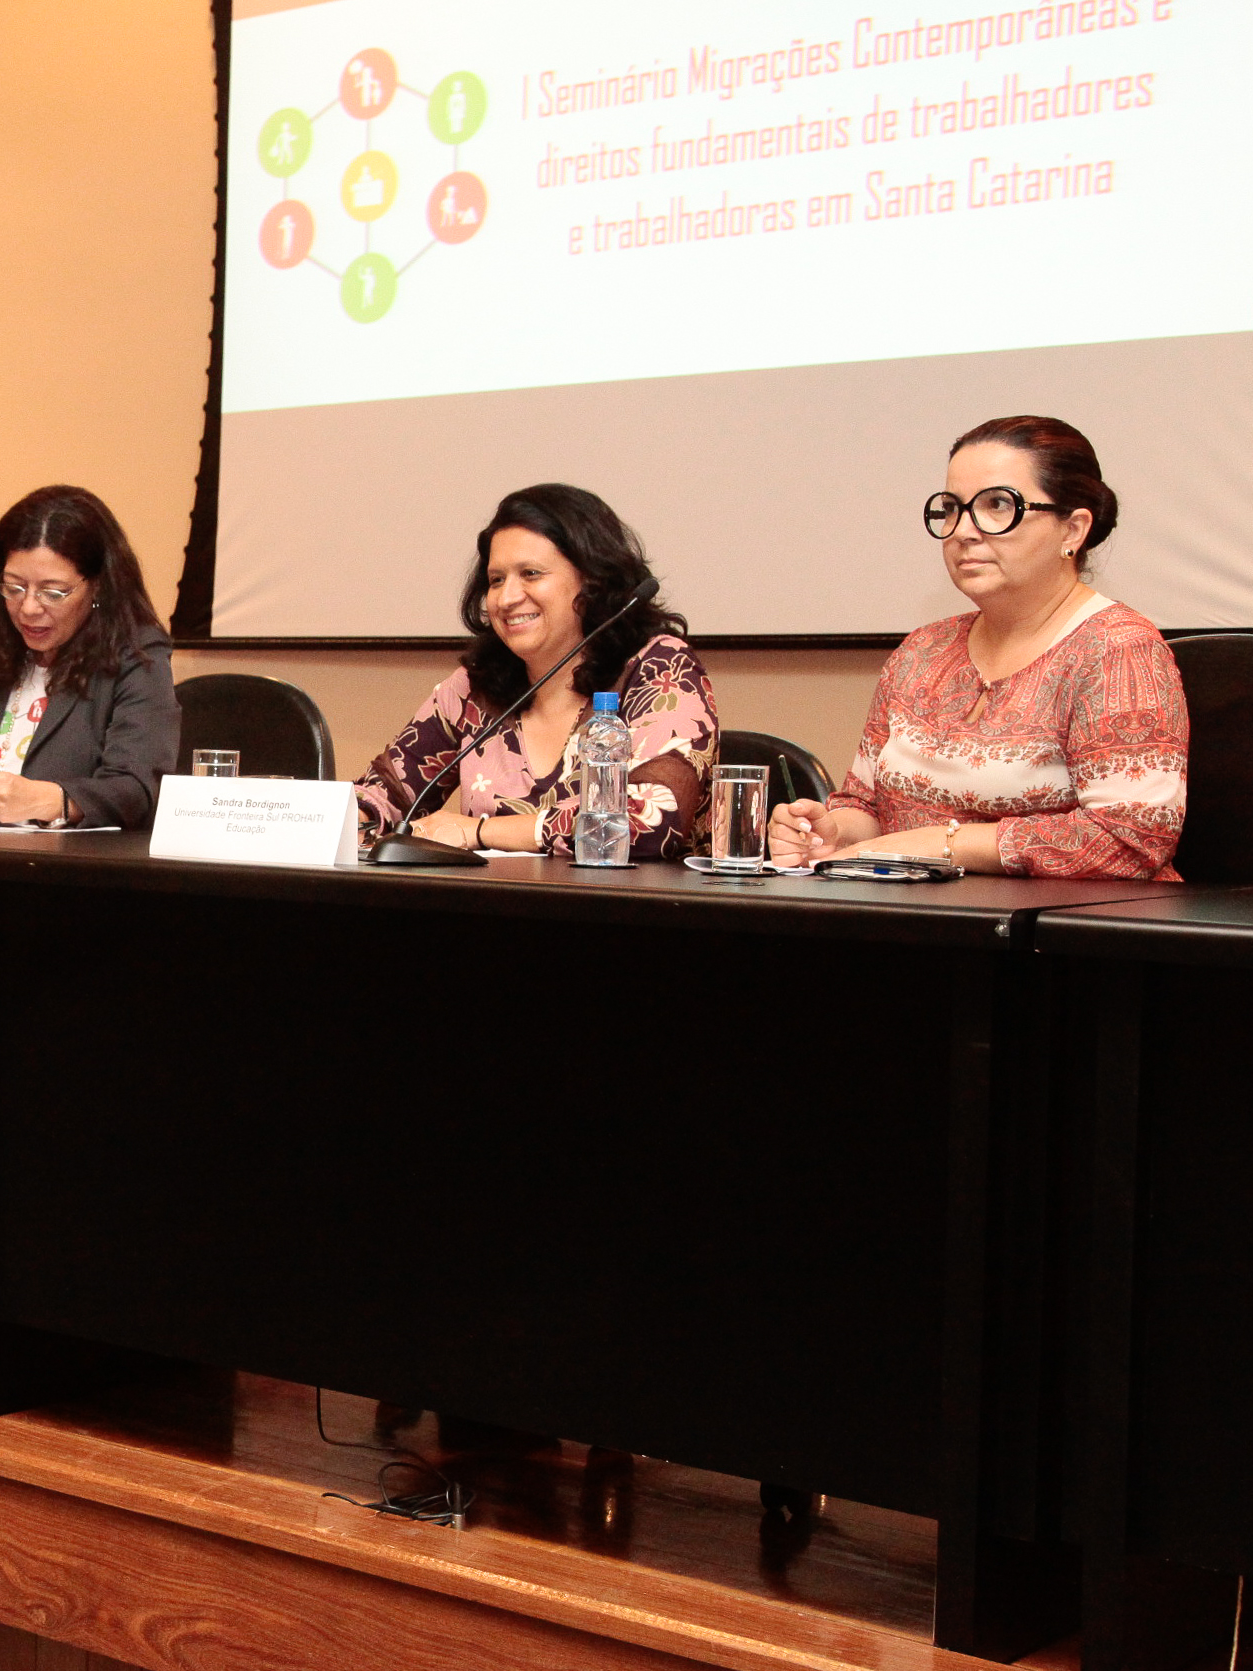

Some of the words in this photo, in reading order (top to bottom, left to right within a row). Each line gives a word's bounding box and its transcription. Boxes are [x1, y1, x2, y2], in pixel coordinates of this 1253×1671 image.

[537, 58, 680, 119] Seminário
[687, 38, 845, 101] Migrações
[851, 0, 1144, 70] Contemporâneas
[536, 142, 643, 189] direitos
[649, 108, 853, 174] fundamentais
[860, 94, 900, 146] de
[909, 65, 1159, 139] trabalhadores
[568, 225, 585, 256] e
[593, 190, 799, 254] trabalhadoras
[806, 192, 855, 229] em
[863, 171, 957, 223] Santa
[966, 153, 1118, 210] Catarina
[174, 807, 226, 820] Universidade
[227, 810, 264, 822] Fronteira
[266, 812, 280, 822] Sul
[281, 813, 324, 823] PROHAITI
[211, 796, 243, 808] Sandra
[245, 798, 291, 811] Bordignon
[226, 822, 266, 835] Educação
